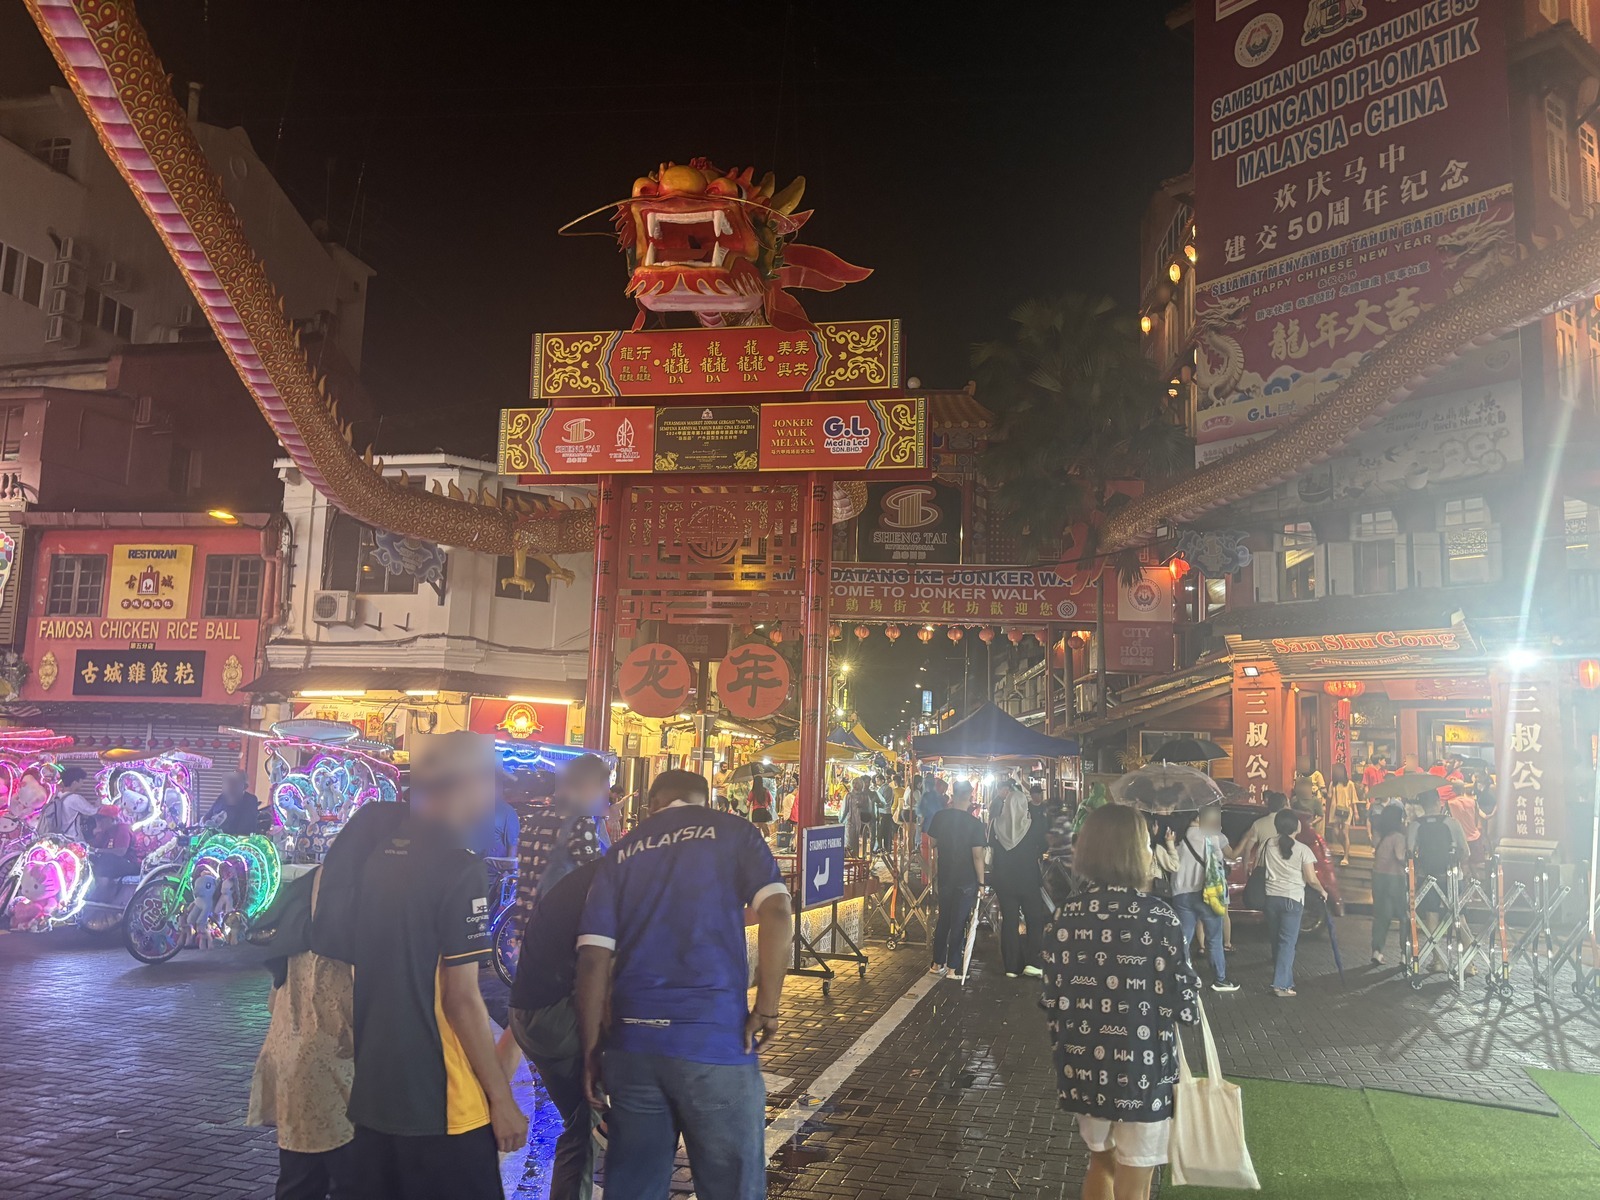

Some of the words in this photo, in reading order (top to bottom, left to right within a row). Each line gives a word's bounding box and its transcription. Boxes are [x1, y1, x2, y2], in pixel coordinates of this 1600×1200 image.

[1211, 64, 1296, 120] SAMBUTAN
[1297, 38, 1356, 84] ULANG
[1356, 8, 1420, 58] TAHUN
[1421, 0, 1452, 31] KE
[1212, 81, 1329, 160] HUBUNGAN
[1331, 17, 1481, 110] DIPLOMATIK
[1236, 115, 1349, 188] MALAYSIA
[1364, 76, 1448, 137] CHINA
[1273, 143, 1406, 213] 欢庆马中
[1211, 269, 1267, 297] SELAMAT
[1266, 242, 1348, 279] MENYAMBUT
[1351, 227, 1399, 251] TAHUN
[1402, 210, 1444, 236] BARU
[1447, 199, 1489, 223] CINA
[1252, 277, 1292, 297] HAPPY
[1296, 258, 1354, 283] CHINESE
[1359, 247, 1389, 264] NEW
[1394, 234, 1433, 254] YEAR
[669, 376, 684, 384] DA
[706, 375, 721, 383] DA
[743, 374, 758, 382] DA
[773, 419, 814, 428] JONKER
[777, 429, 807, 437] WALK
[823, 416, 871, 438] G.L.
[771, 438, 815, 447] MELAKA
[825, 438, 851, 447] Media
[852, 438, 868, 447] Led
[873, 531, 921, 544] SHENG
[923, 532, 948, 544] TAI
[128, 549, 177, 559] RESTORAN
[830, 567, 911, 584] DATANG
[914, 569, 943, 585] KE
[948, 569, 1035, 587] JONKER
[880, 586, 905, 598] TO
[910, 587, 986, 600] JONKER
[992, 588, 1047, 601] WALK
[38, 620, 93, 639] FAMOSA
[100, 621, 159, 640] CHICKEN
[166, 621, 198, 640] RICE
[205, 622, 241, 640] BALL
[1122, 628, 1152, 638] CITY
[1120, 647, 1153, 657] HOPE
[1272, 638, 1323, 654] San
[1322, 634, 1377, 651] Shu
[1375, 631, 1460, 651] Gong
[81, 660, 196, 685] 古城雞飯粒
[625, 648, 684, 699] 龙
[727, 648, 782, 708] 年
[1245, 690, 1269, 779] 三叔公
[1508, 685, 1543, 791] 三叔公
[617, 826, 716, 864] MALAYSIA
